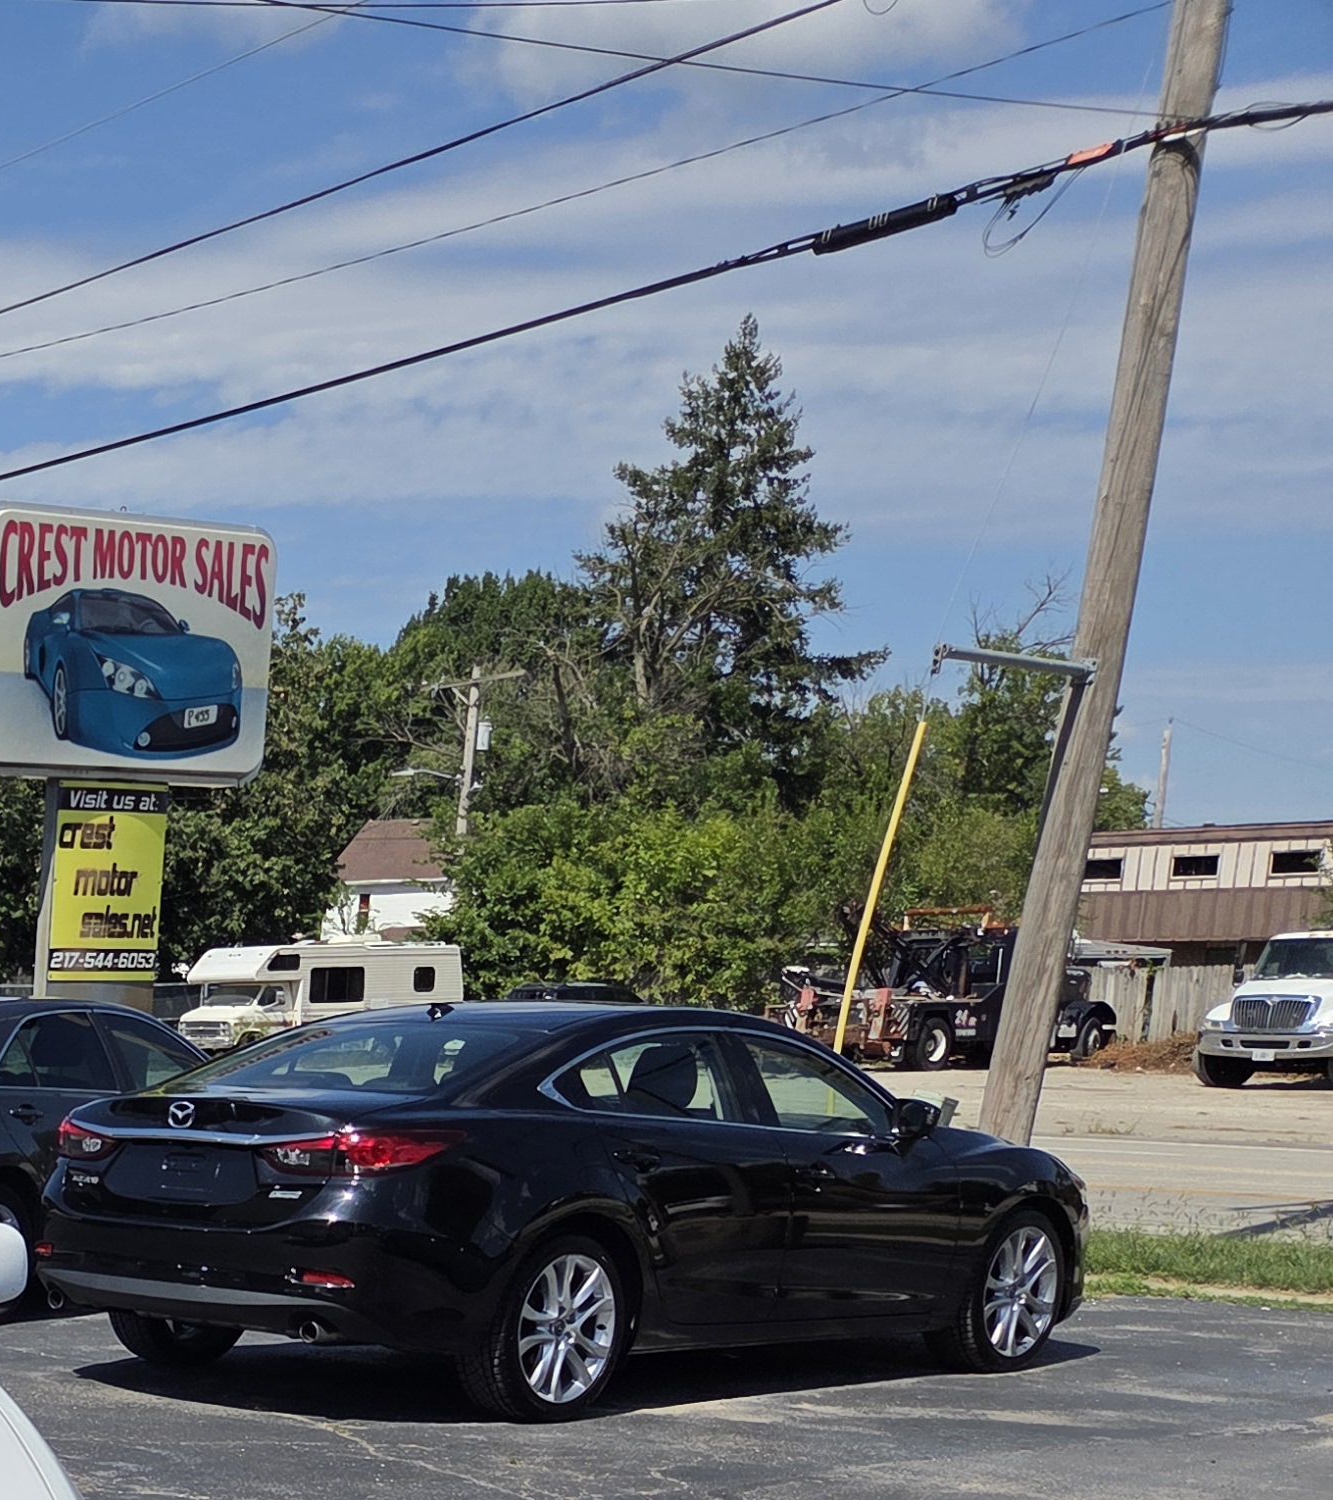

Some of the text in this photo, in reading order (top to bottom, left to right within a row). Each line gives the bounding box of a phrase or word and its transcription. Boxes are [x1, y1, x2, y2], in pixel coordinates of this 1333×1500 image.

[92, 528, 187, 589] MOTOR
[194, 537, 270, 630] SALES
[70, 789, 161, 812] Visit us at:
[59, 815, 115, 850] crest
[73, 862, 138, 897] motor
[80, 905, 156, 938] sales.net
[49, 951, 156, 969] 217-544-6053
